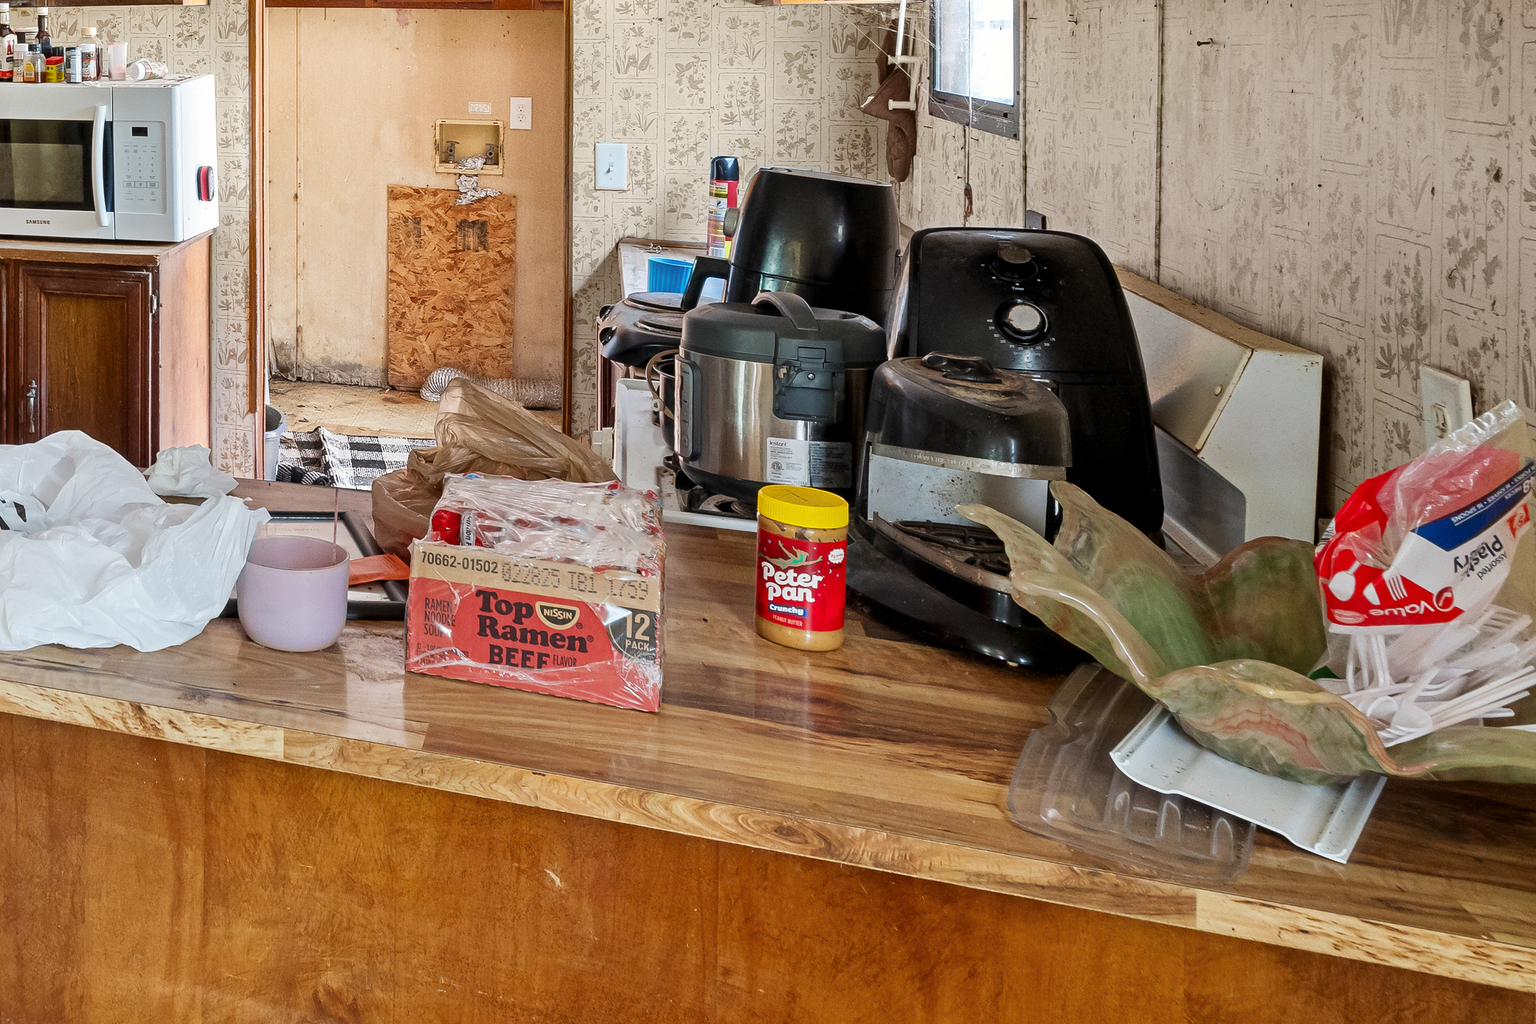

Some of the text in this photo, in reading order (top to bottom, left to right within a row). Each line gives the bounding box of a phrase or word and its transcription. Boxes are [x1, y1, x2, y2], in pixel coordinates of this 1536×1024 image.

[421, 550, 499, 574] 70662-01502
[761, 561, 825, 589] Peter
[765, 581, 816, 603] Pan
[424, 597, 453, 613] RAMEN
[475, 590, 534, 625] Top
[543, 608, 573, 621] NISSIN
[769, 603, 805, 616] Crunchy
[1369, 599, 1435, 617] Value
[424, 611, 456, 627] NOODLE
[625, 613, 651, 641] 12
[772, 614, 803, 627] PEANUT BUTTER
[477, 615, 589, 653] Ramen
[625, 639, 650, 652] PACK
[488, 644, 551, 669] BEEF
[552, 654, 577, 667] FLAVOR
